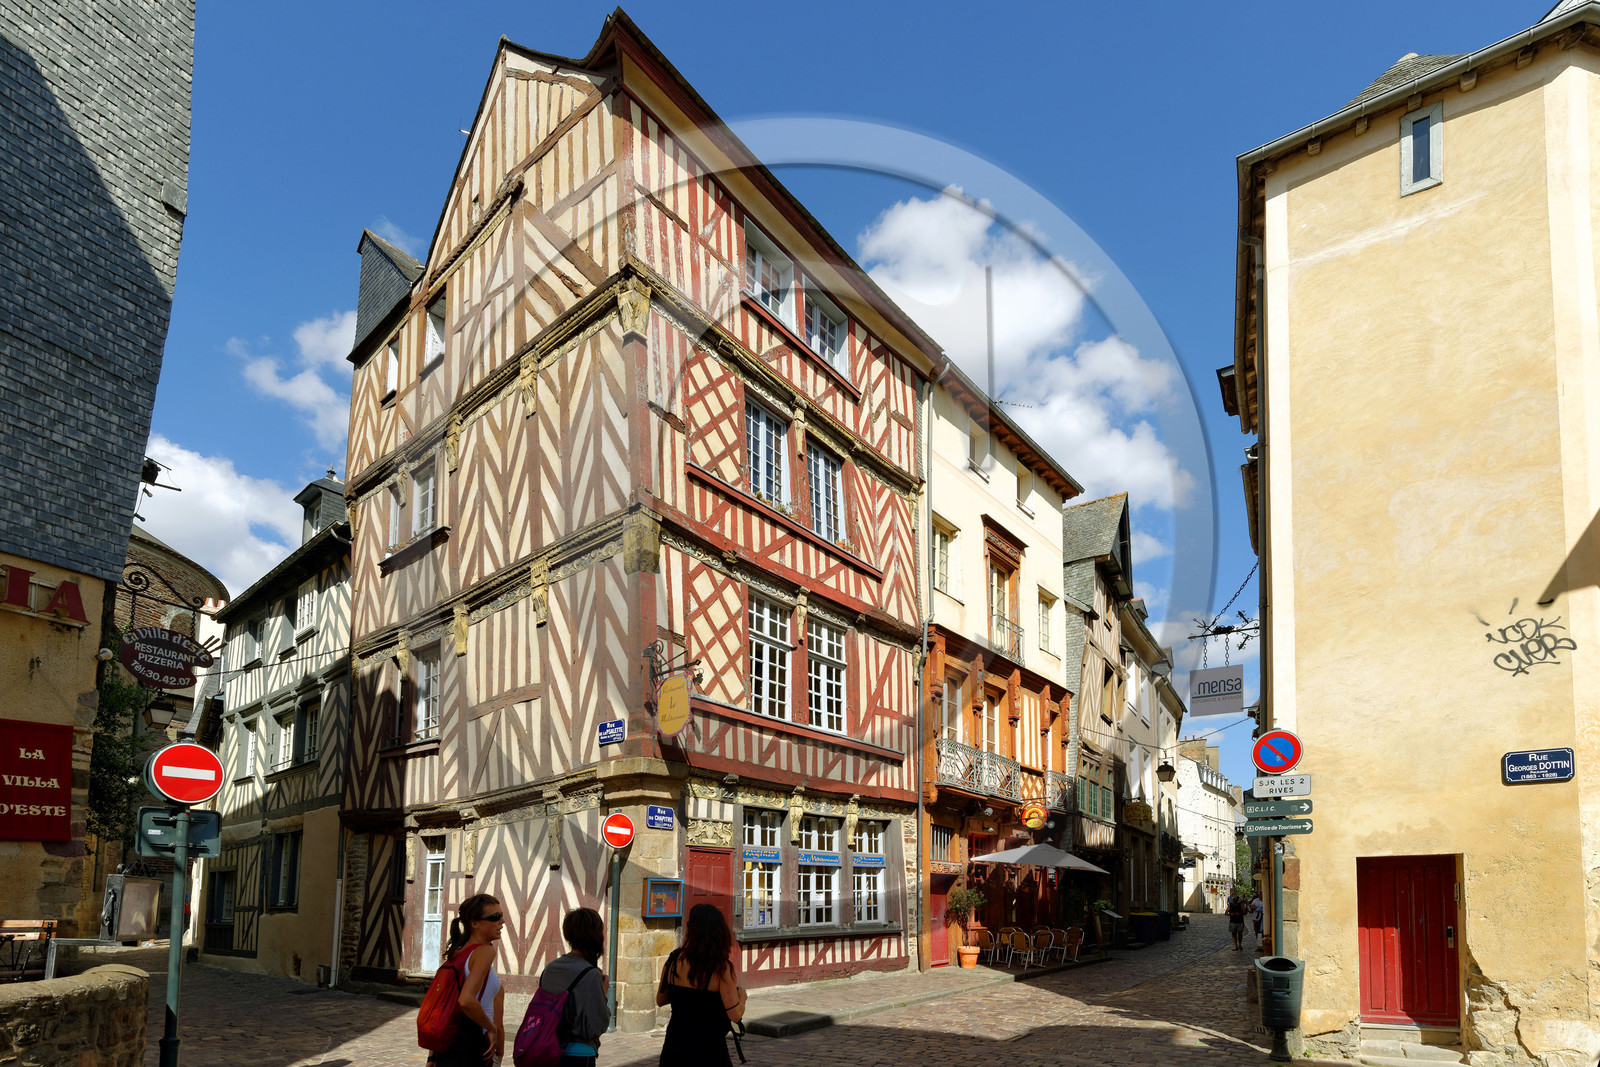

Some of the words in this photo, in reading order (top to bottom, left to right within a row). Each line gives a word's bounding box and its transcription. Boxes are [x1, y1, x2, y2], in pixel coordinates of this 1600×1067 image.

[134, 642, 196, 664] RESTAURANT
[138, 653, 184, 671] PIZZERIA
[1197, 677, 1242, 695] mensa
[19, 748, 45, 760] LA
[1538, 760, 1570, 770] DOTTIN
[2, 774, 60, 788] VILLA
